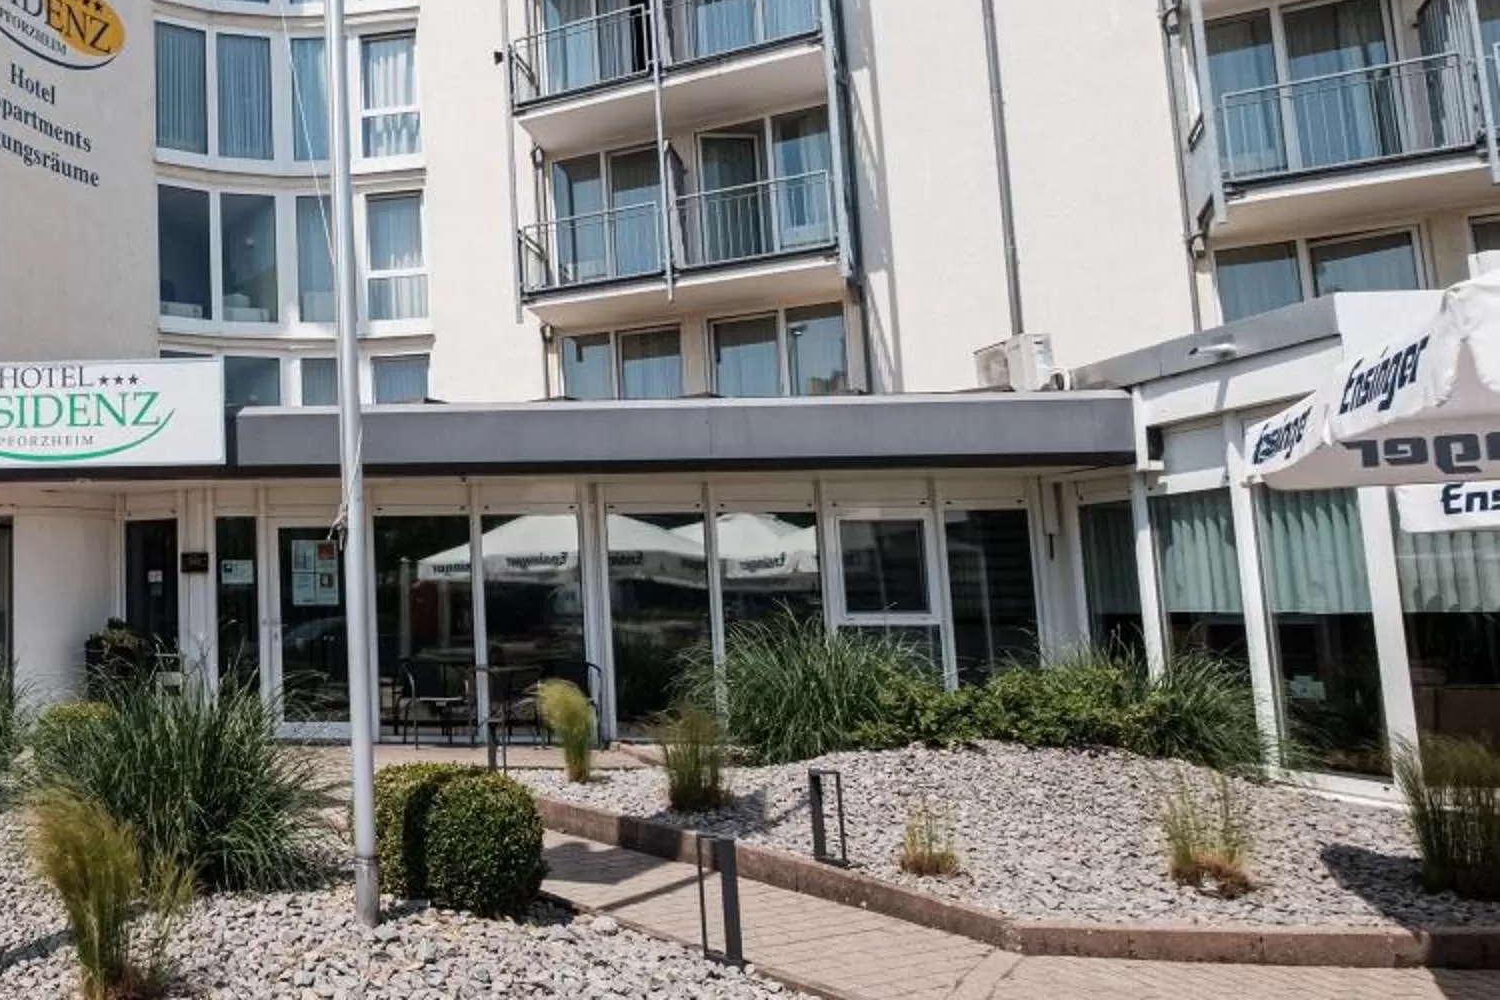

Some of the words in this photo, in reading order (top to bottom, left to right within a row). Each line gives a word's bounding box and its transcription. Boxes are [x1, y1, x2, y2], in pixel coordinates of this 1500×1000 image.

[0, 6, 68, 56] PFORZHEIM
[9, 60, 56, 105] Hotel
[1338, 334, 1431, 416] Ensinger
